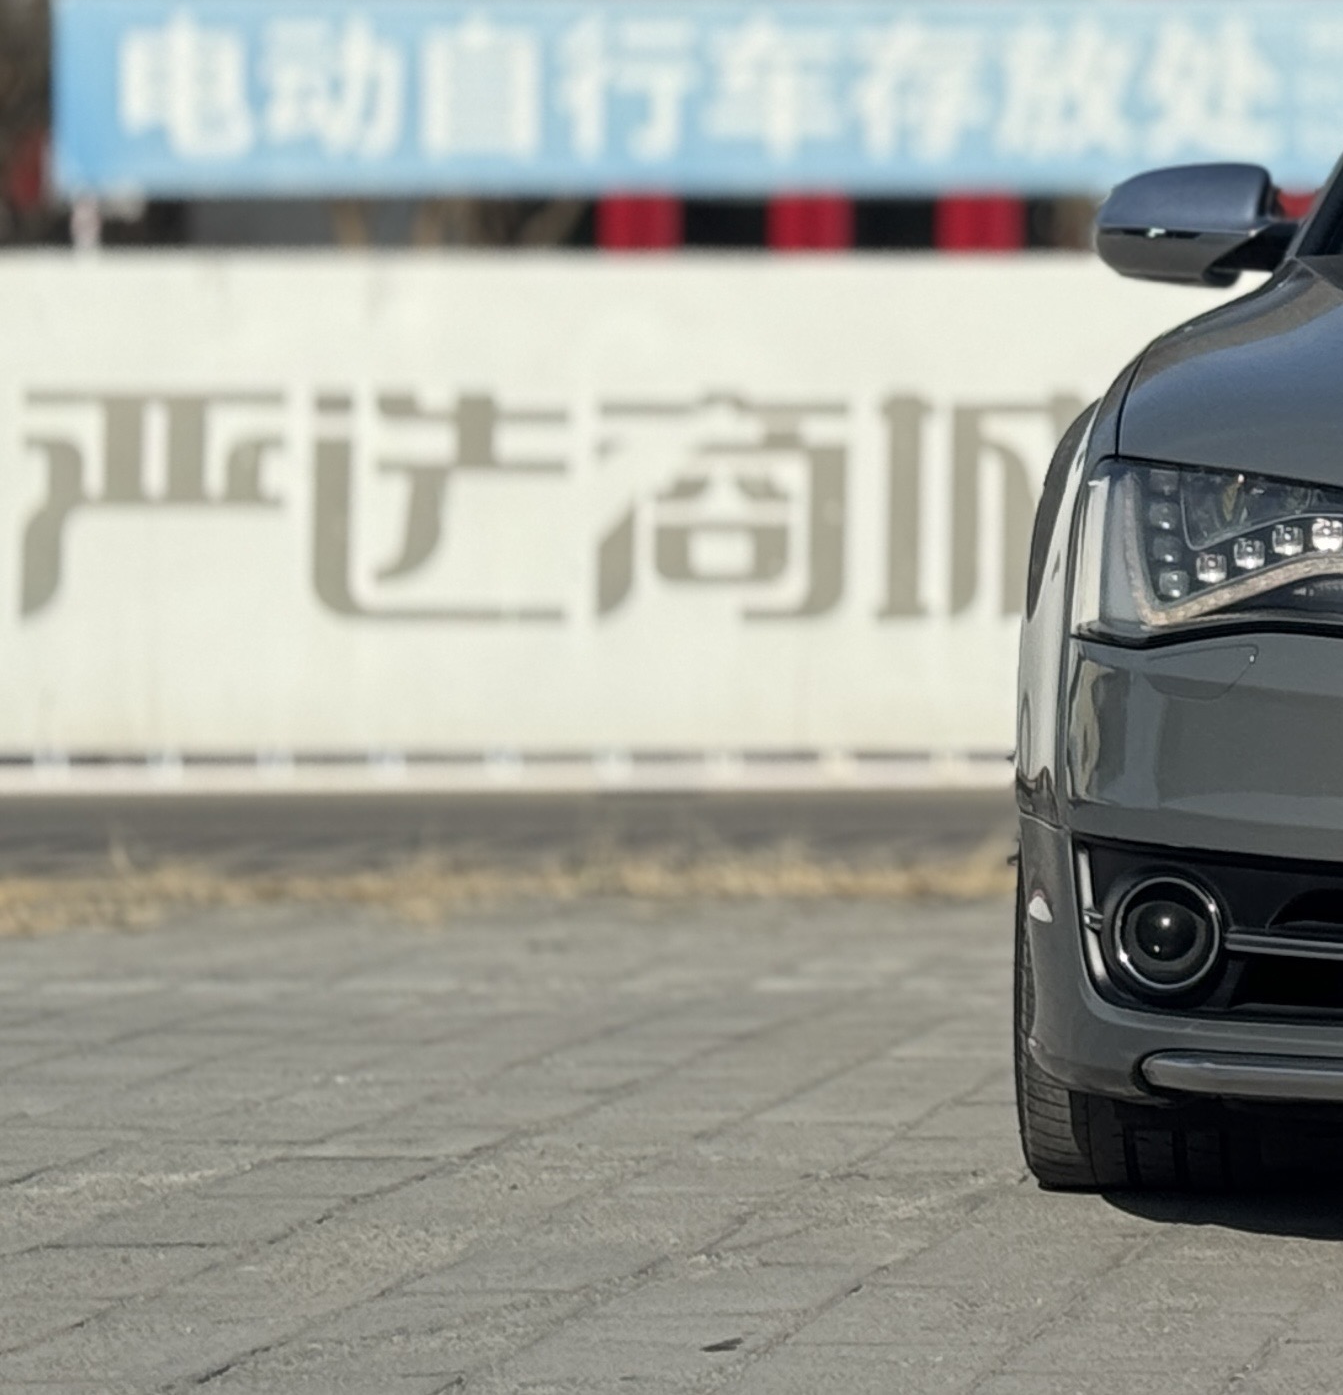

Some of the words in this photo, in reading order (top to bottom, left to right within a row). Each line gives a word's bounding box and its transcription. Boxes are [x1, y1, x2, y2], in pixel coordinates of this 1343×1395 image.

[120, 9, 1276, 161] 电动自行车存放处
